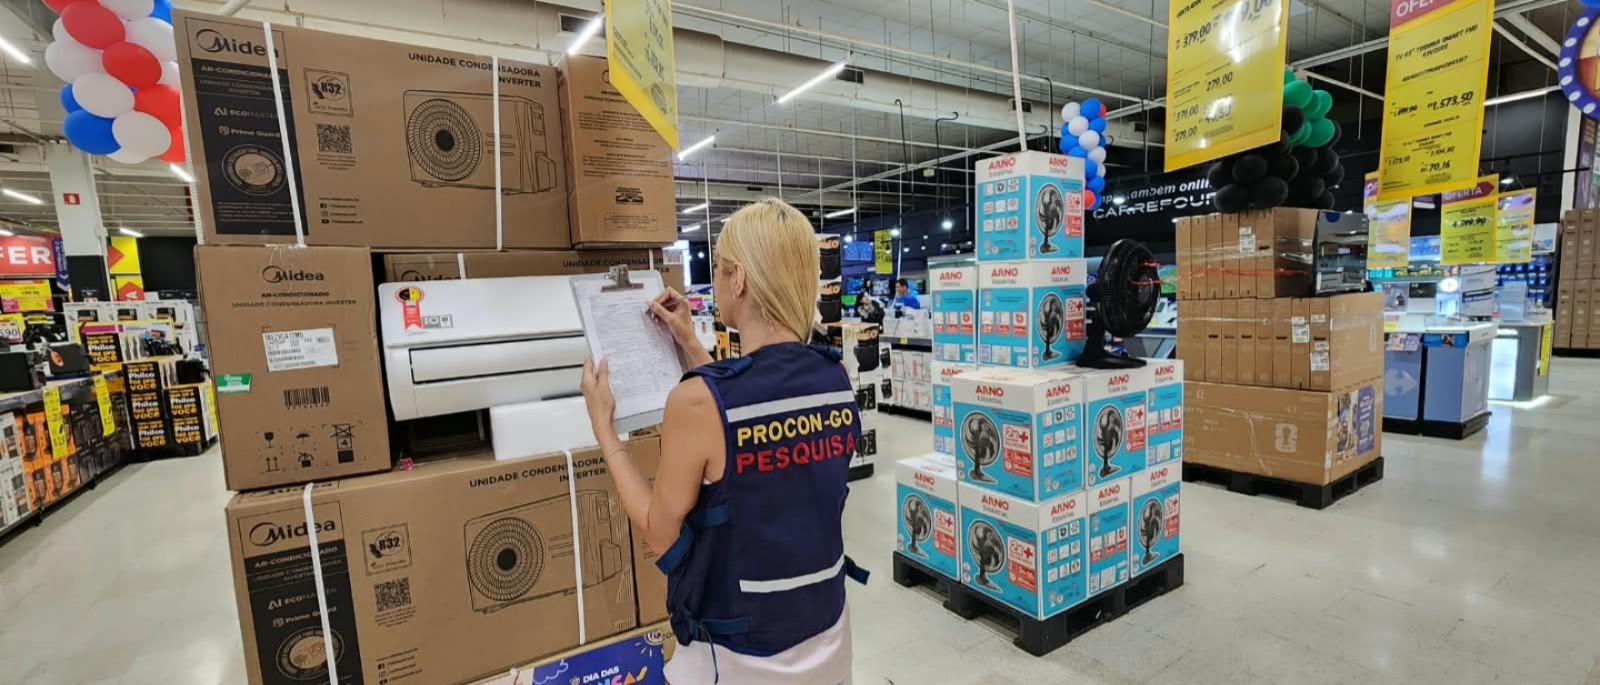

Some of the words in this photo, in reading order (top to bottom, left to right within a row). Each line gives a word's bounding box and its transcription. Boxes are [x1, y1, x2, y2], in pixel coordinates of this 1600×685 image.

[408, 52, 456, 67] UNIDADE
[201, 65, 280, 80] AR-CONDICIONA
[320, 81, 341, 95] R32
[498, 75, 541, 88] NVERTER
[988, 157, 1016, 170] ARNO
[1049, 157, 1068, 167] ARNO
[262, 265, 325, 283] Midea
[939, 271, 962, 281] ARNO
[991, 268, 1018, 278] ARNO
[1051, 265, 1070, 275] ARNO
[261, 291, 330, 299] AR-CONDICIONADO
[1155, 365, 1175, 376] ARNO
[130, 382, 157, 391] você
[1107, 374, 1129, 387] ARNO
[975, 385, 1004, 397] ARNO
[1046, 384, 1071, 398] ARNO
[134, 411, 160, 419] você
[171, 407, 197, 416] você
[174, 424, 200, 432] Philco
[737, 408, 853, 447] PROCON-GO
[140, 438, 166, 448] você
[176, 434, 201, 444] você
[736, 432, 855, 474] PESQUISA
[469, 472, 519, 488] UNIDADE
[559, 467, 606, 482] INERTER
[914, 472, 935, 485] ARNO
[1150, 468, 1168, 481] ARNO
[1098, 484, 1120, 500] ARNO
[981, 494, 1009, 511] ARNO
[1050, 499, 1076, 516] ARNO
[249, 520, 336, 546] Midea
[378, 536, 400, 550] R32
[254, 546, 338, 568] AR-CONDICIOADO
[267, 598, 282, 610] AI
[284, 587, 337, 605] ECOMAER
[583, 672, 600, 684] DIA
[601, 665, 620, 678] DAS
